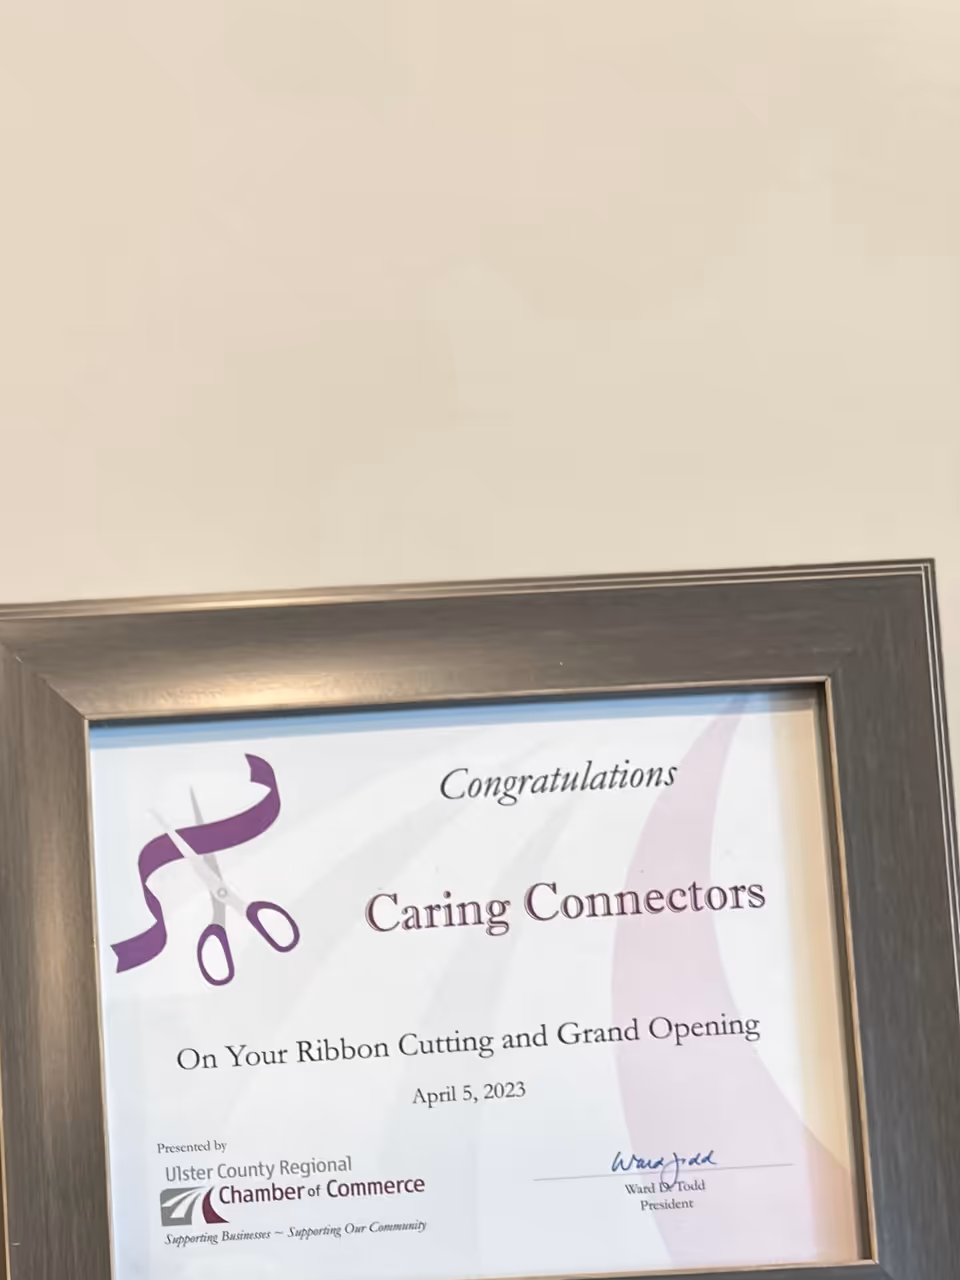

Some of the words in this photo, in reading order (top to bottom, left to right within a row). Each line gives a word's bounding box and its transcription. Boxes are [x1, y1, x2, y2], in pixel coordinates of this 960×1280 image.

[440, 760, 678, 806] Congratulations
[365, 890, 510, 936] Caring
[524, 881, 766, 922] Connectors
[177, 1048, 218, 1070] On
[224, 1044, 288, 1068] Your
[296, 1038, 390, 1063] Ribbon
[398, 1029, 494, 1058] Cutting
[502, 1024, 548, 1049] and
[557, 1018, 641, 1045] Grand
[648, 1013, 761, 1046] Opening
[412, 1086, 456, 1108] April
[462, 1085, 478, 1103] 5,
[484, 1081, 526, 1100] 2023
[157, 1141, 211, 1154] Presented
[214, 1140, 228, 1154] by
[165, 1164, 214, 1182] Ulster
[217, 1161, 276, 1181] County
[279, 1155, 352, 1178] Regional
[219, 1183, 305, 1204] Chamber
[307, 1185, 321, 1197] of
[326, 1177, 426, 1198] Commerce
[625, 1183, 655, 1195] Ward
[676, 1179, 706, 1192] Todd
[640, 1199, 695, 1211] President
[164, 1231, 219, 1248] Supporting
[221, 1229, 271, 1242] Businesses
[287, 1224, 342, 1240] Supporting
[344, 1222, 367, 1234] Our
[369, 1218, 427, 1234] Community
